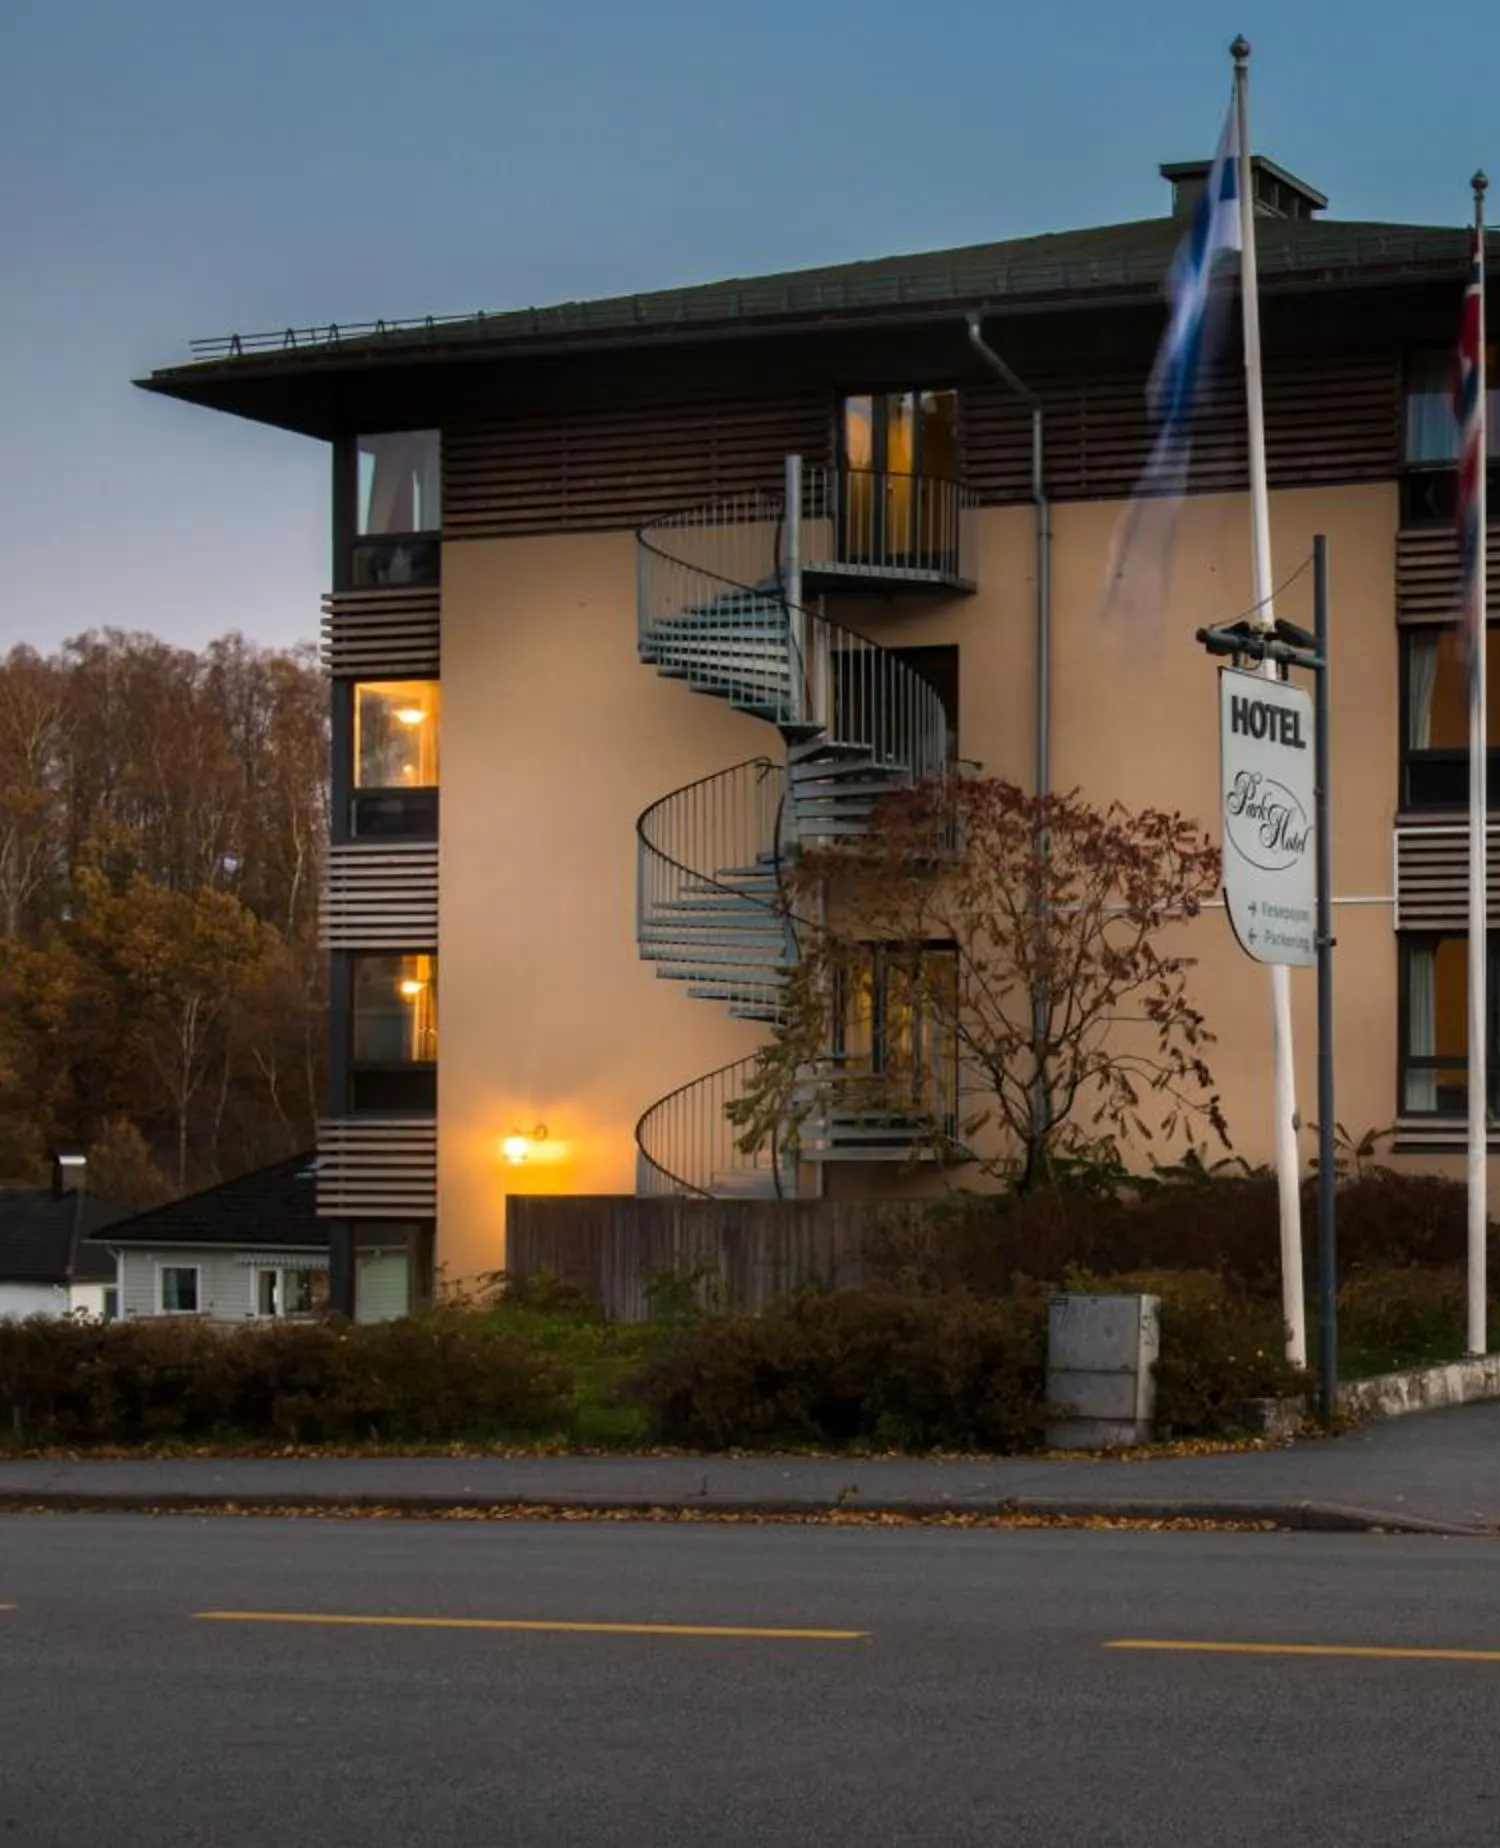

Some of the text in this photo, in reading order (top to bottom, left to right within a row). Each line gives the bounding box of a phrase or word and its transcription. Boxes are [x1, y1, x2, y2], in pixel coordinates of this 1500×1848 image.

[1231, 695, 1307, 749] HOTEL
[1226, 770, 1313, 853] Park Hotel
